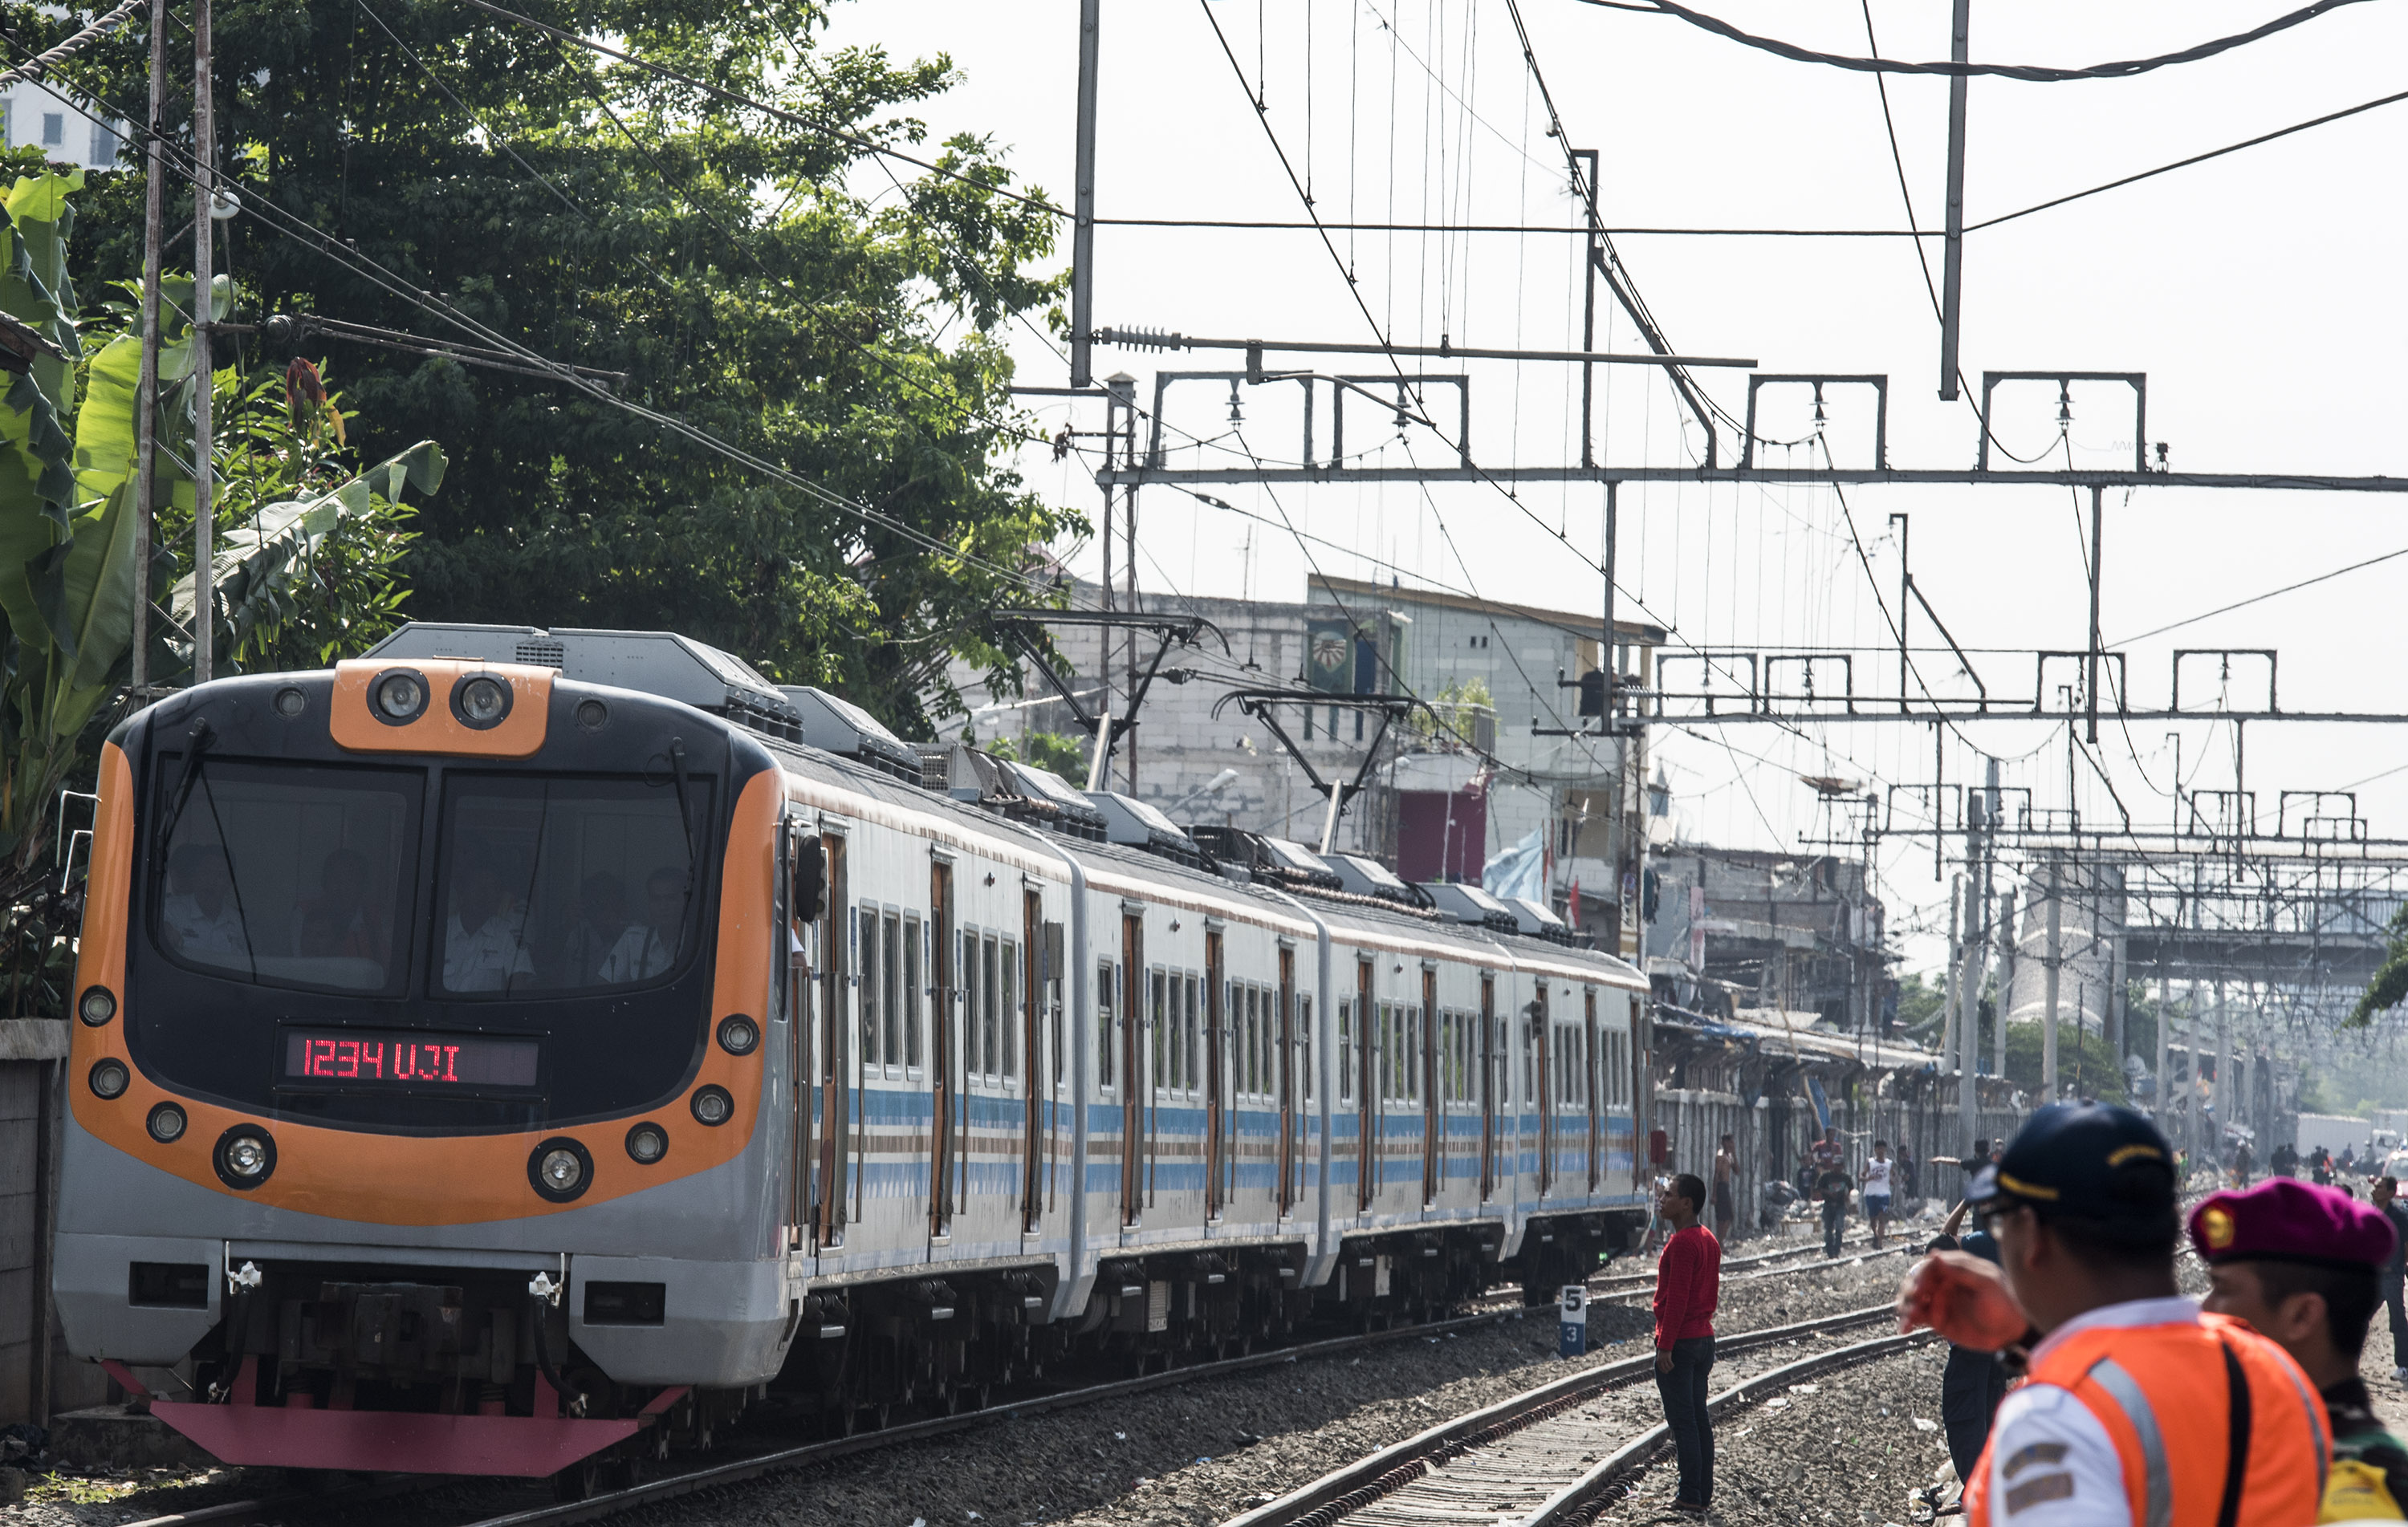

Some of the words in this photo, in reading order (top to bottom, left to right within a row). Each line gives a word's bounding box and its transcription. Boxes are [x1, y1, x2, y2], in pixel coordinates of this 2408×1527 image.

[304, 1039, 384, 1078] 1234
[394, 1043, 460, 1082] UJI
[1565, 1289, 1581, 1312] 5
[1566, 1326, 1577, 1342] 3
